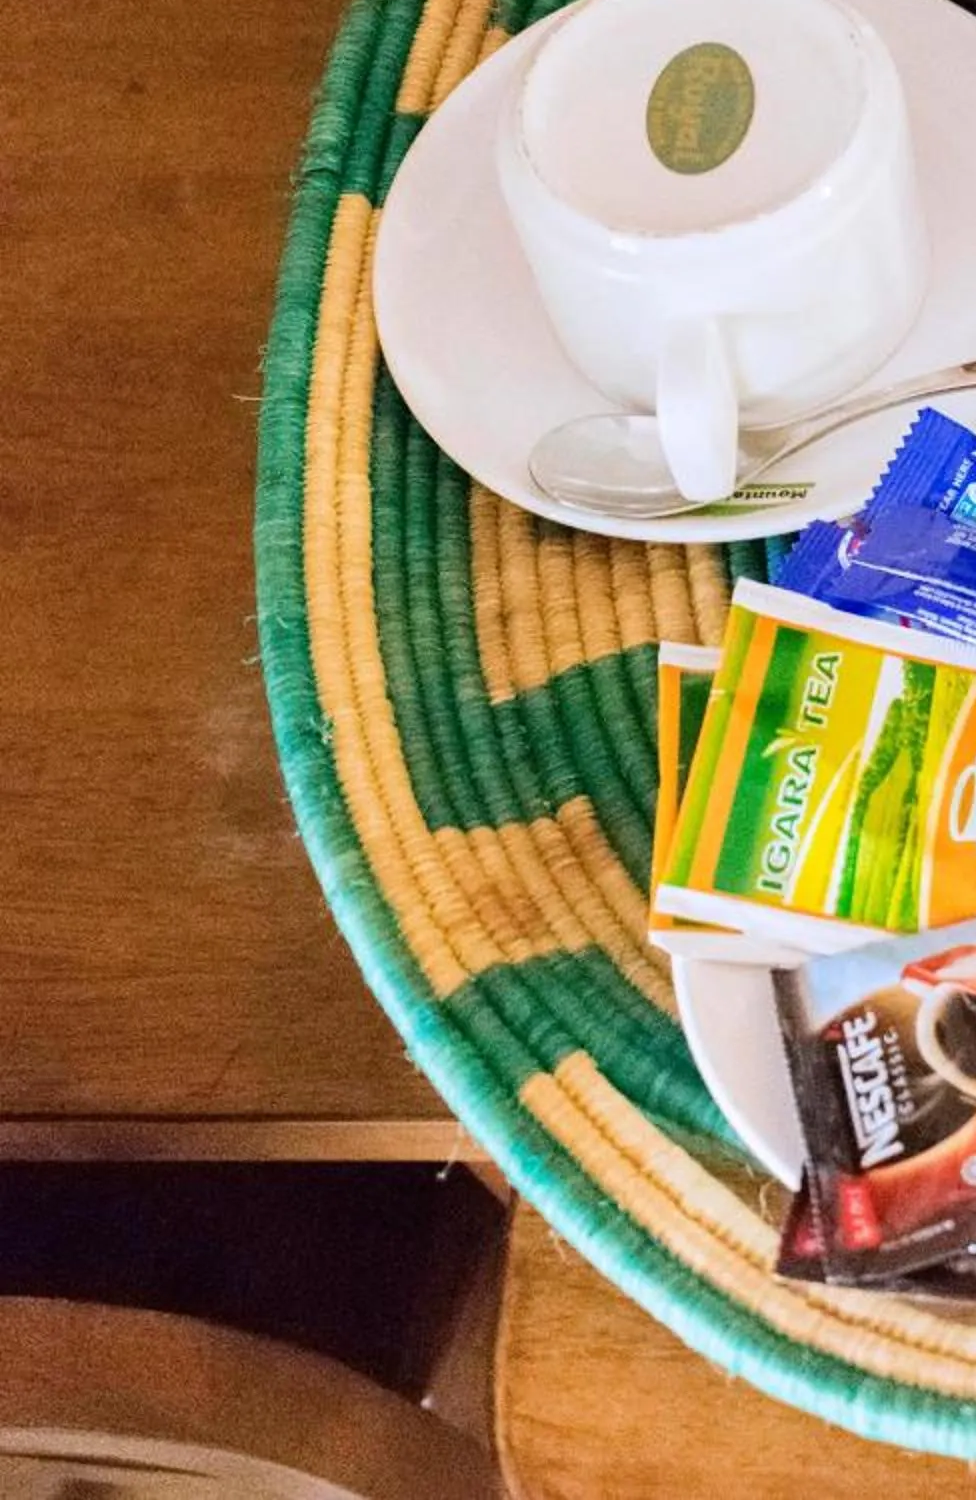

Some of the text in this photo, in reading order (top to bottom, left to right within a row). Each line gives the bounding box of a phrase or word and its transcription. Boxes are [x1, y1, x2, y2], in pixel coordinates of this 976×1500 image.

[758, 651, 842, 892] IGARA TEA
[883, 1029, 915, 1115] CLASSIC
